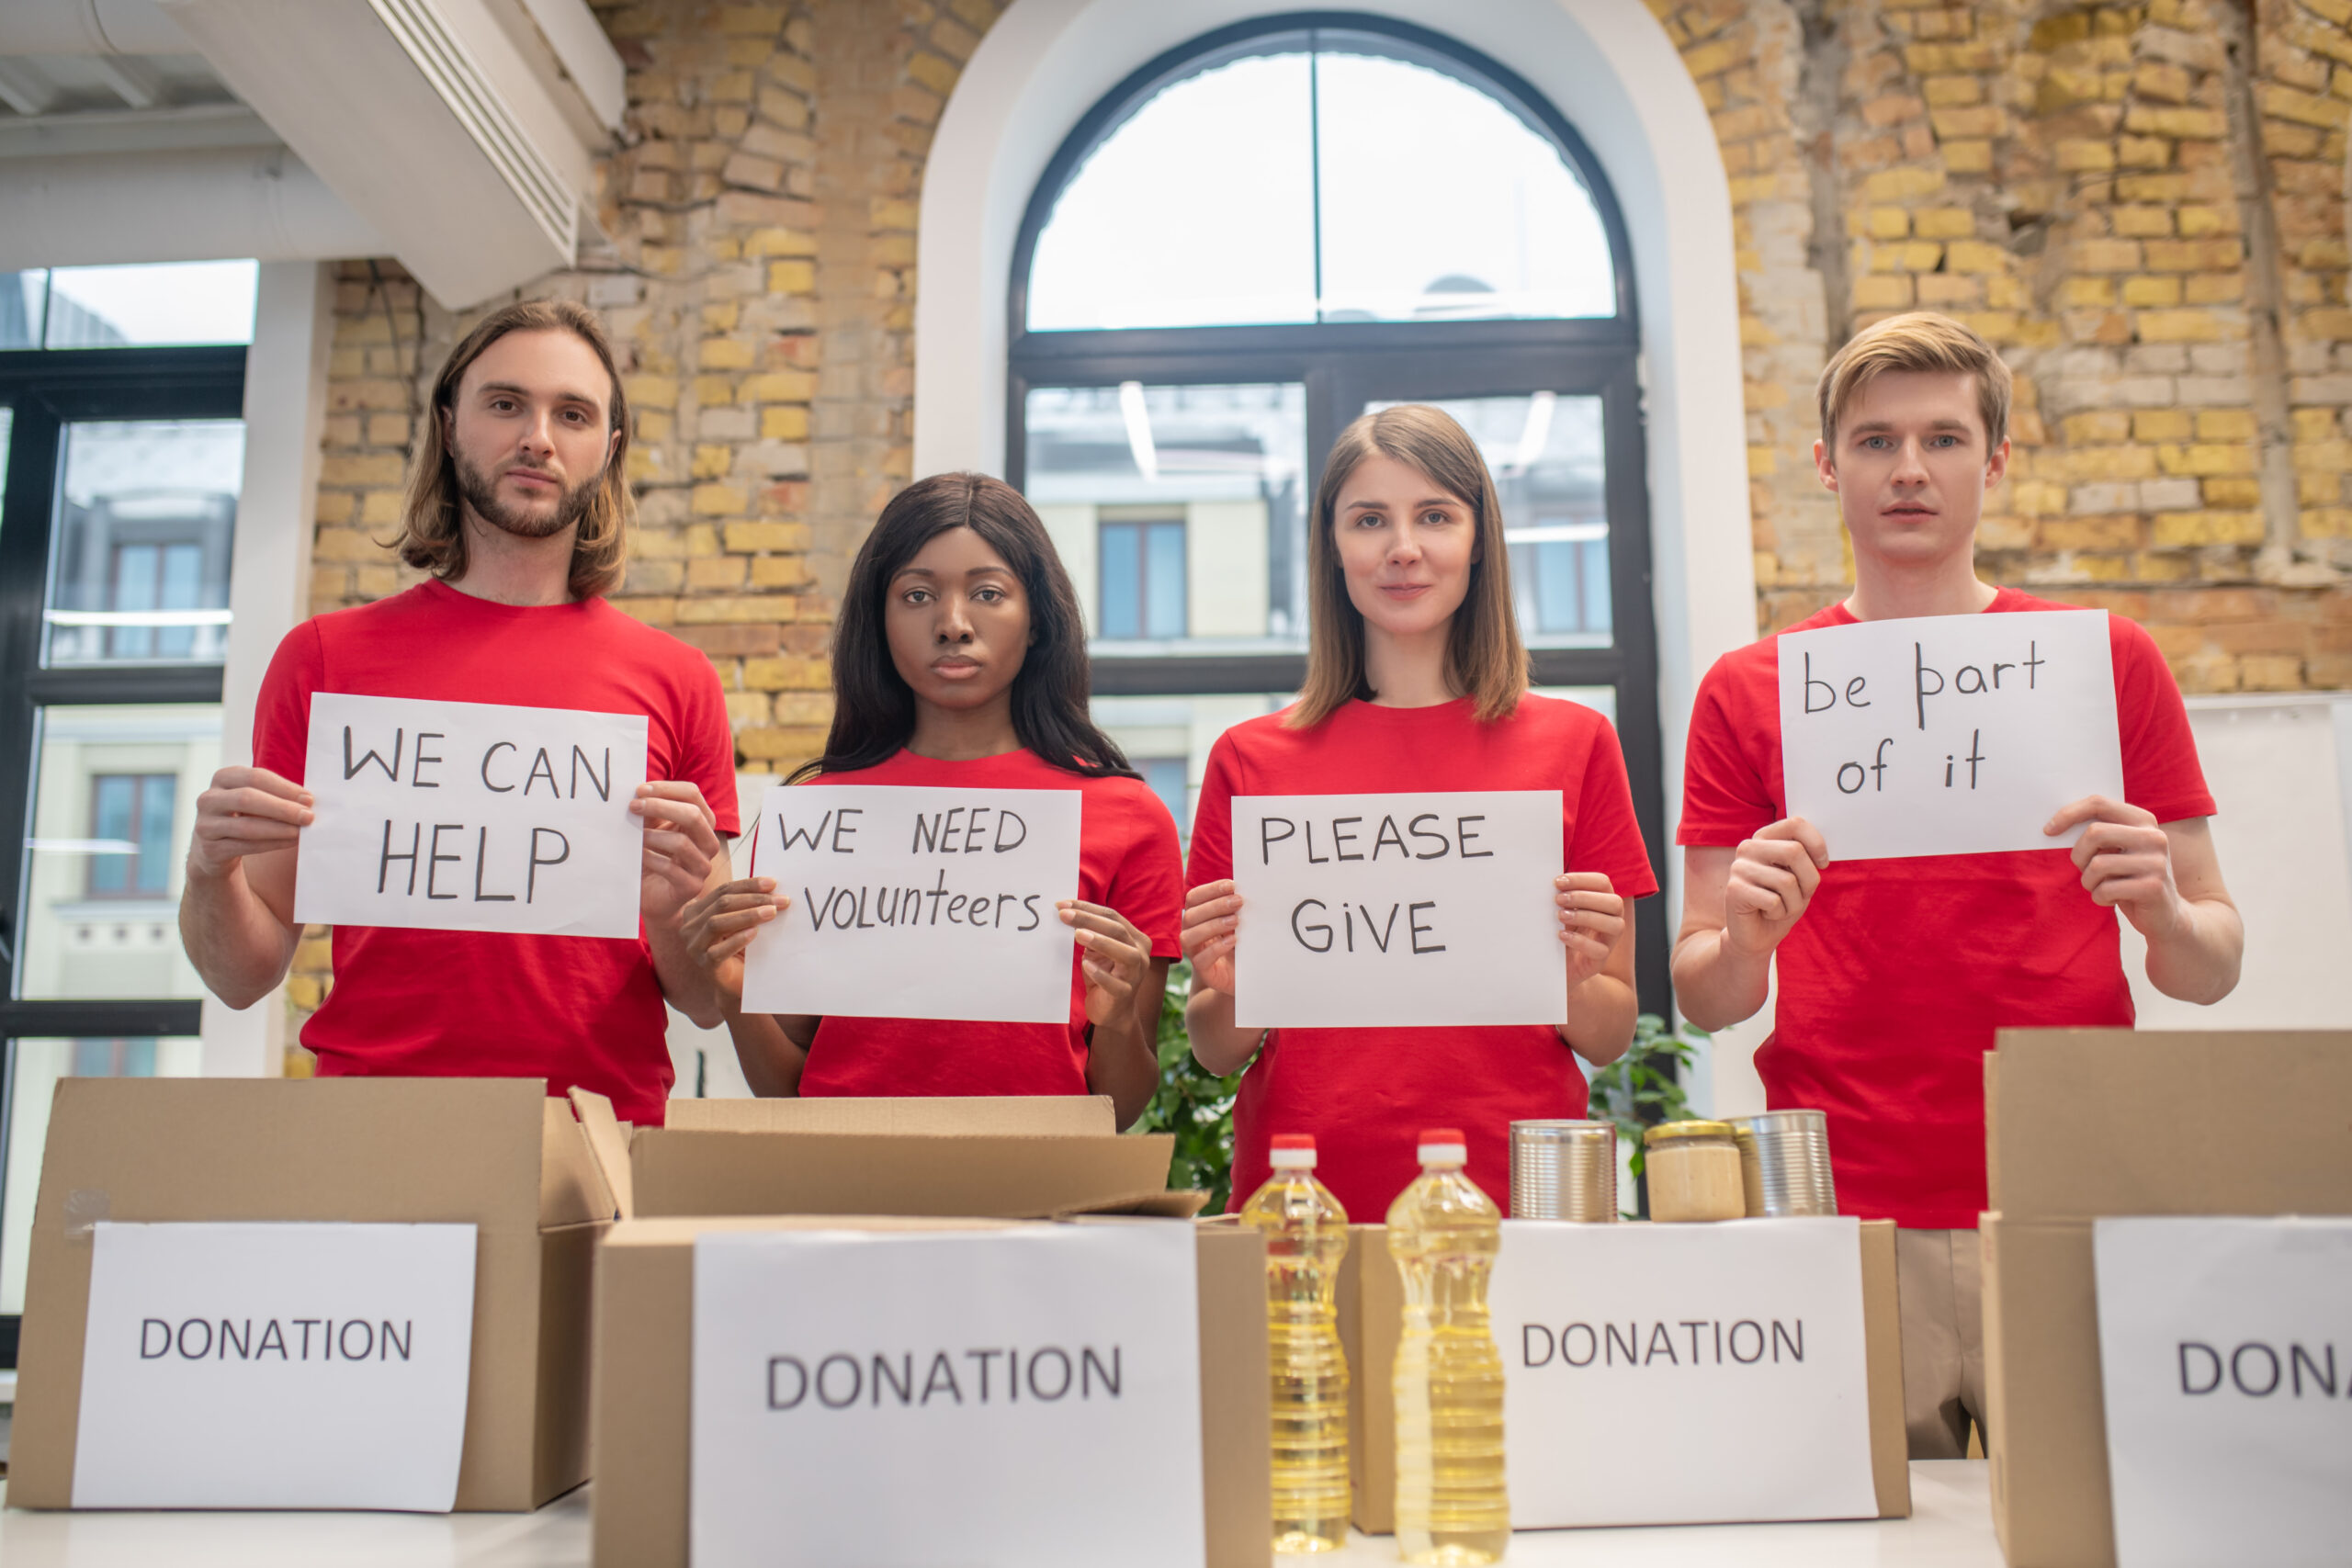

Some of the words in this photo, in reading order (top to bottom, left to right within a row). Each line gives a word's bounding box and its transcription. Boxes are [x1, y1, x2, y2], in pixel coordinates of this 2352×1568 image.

[1804, 651, 1871, 715] be
[1915, 639, 2047, 731] part
[343, 725, 446, 788] WE
[481, 741, 611, 803] CAN
[1837, 738, 1894, 795] of
[1944, 728, 1986, 790] it
[377, 818, 571, 905] HELP
[778, 807, 864, 854] WE
[911, 807, 1027, 855] NEED
[1261, 813, 1495, 866] PLEASE
[140, 1317, 413, 1361] DONATION
[1522, 1319, 1804, 1368] DONATION
[2177, 1341, 2352, 1398] DON
[766, 1345, 1123, 1410] DONATION
